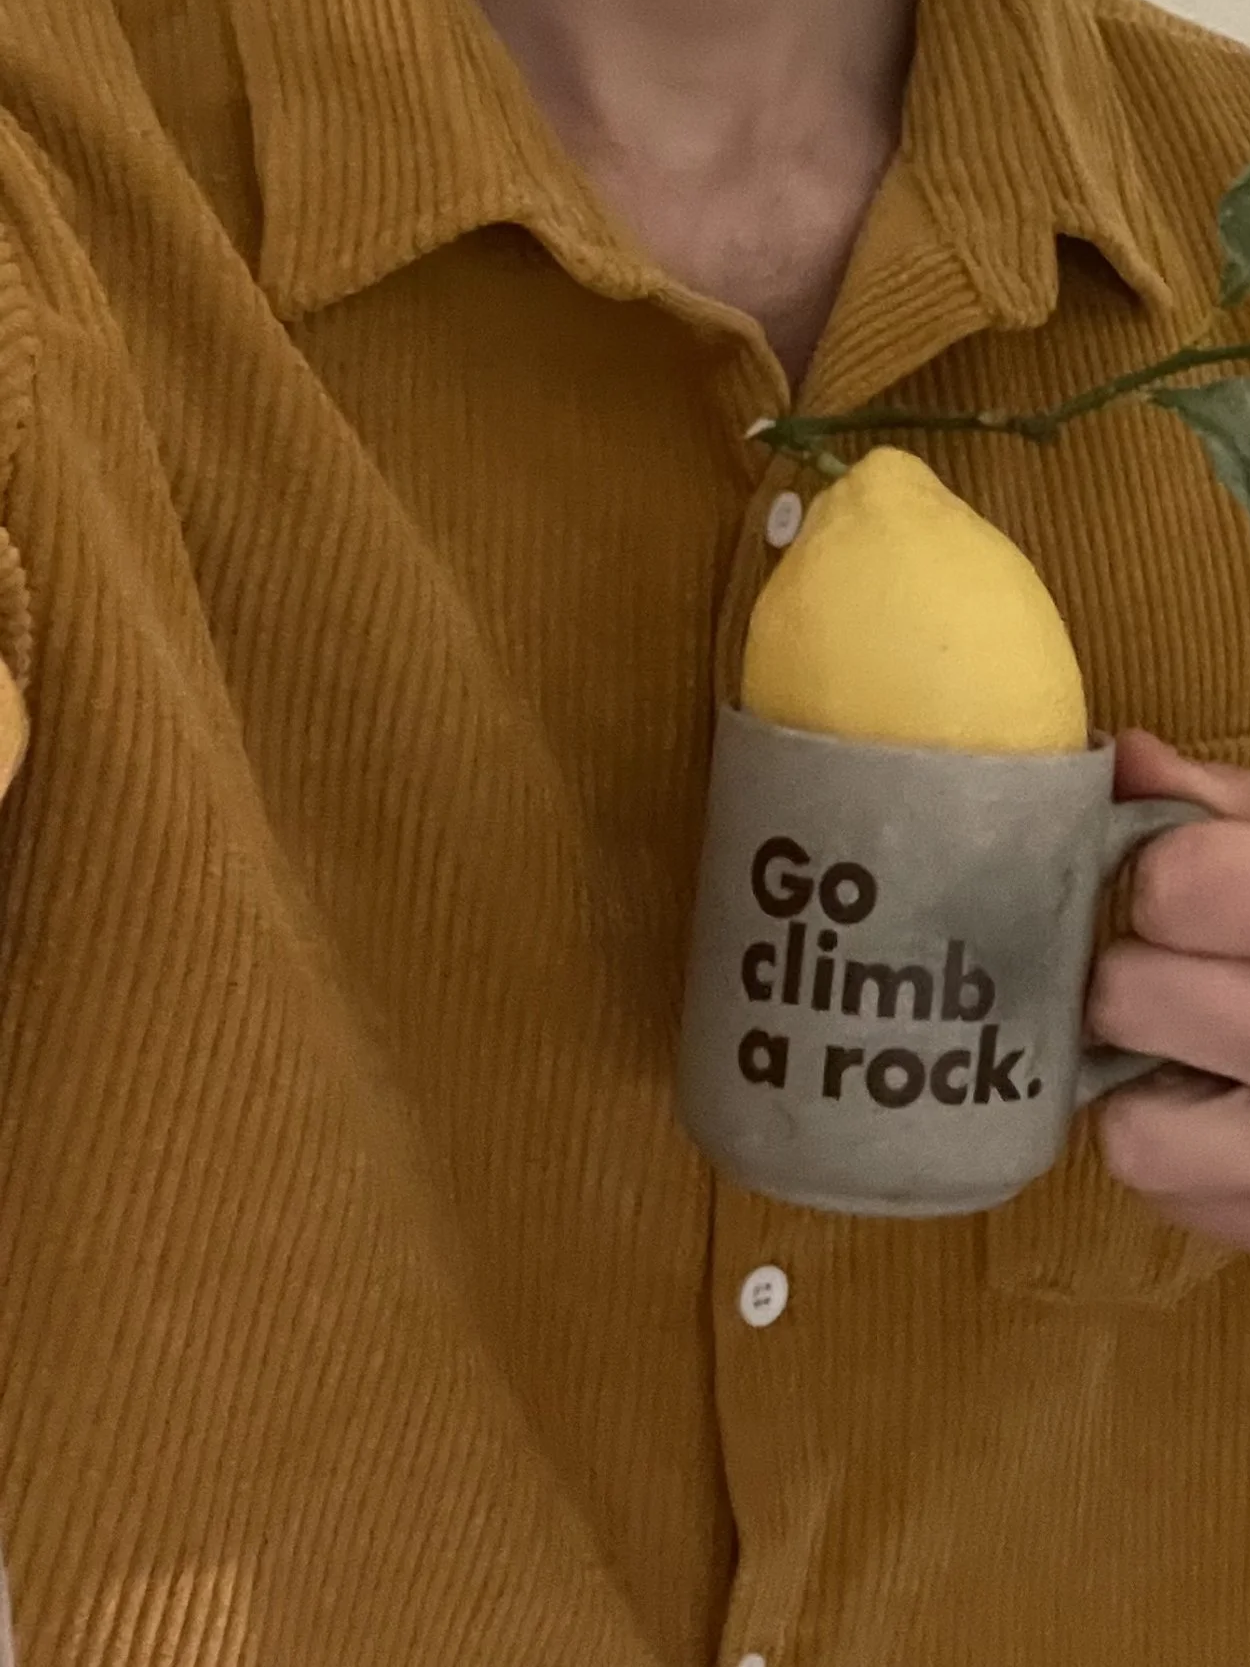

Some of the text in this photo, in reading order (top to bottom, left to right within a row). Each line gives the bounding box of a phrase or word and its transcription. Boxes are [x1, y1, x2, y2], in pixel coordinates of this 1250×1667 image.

[751, 836, 878, 924] Go
[741, 922, 996, 1021] climb
[738, 1024, 1043, 1109] a rock.
